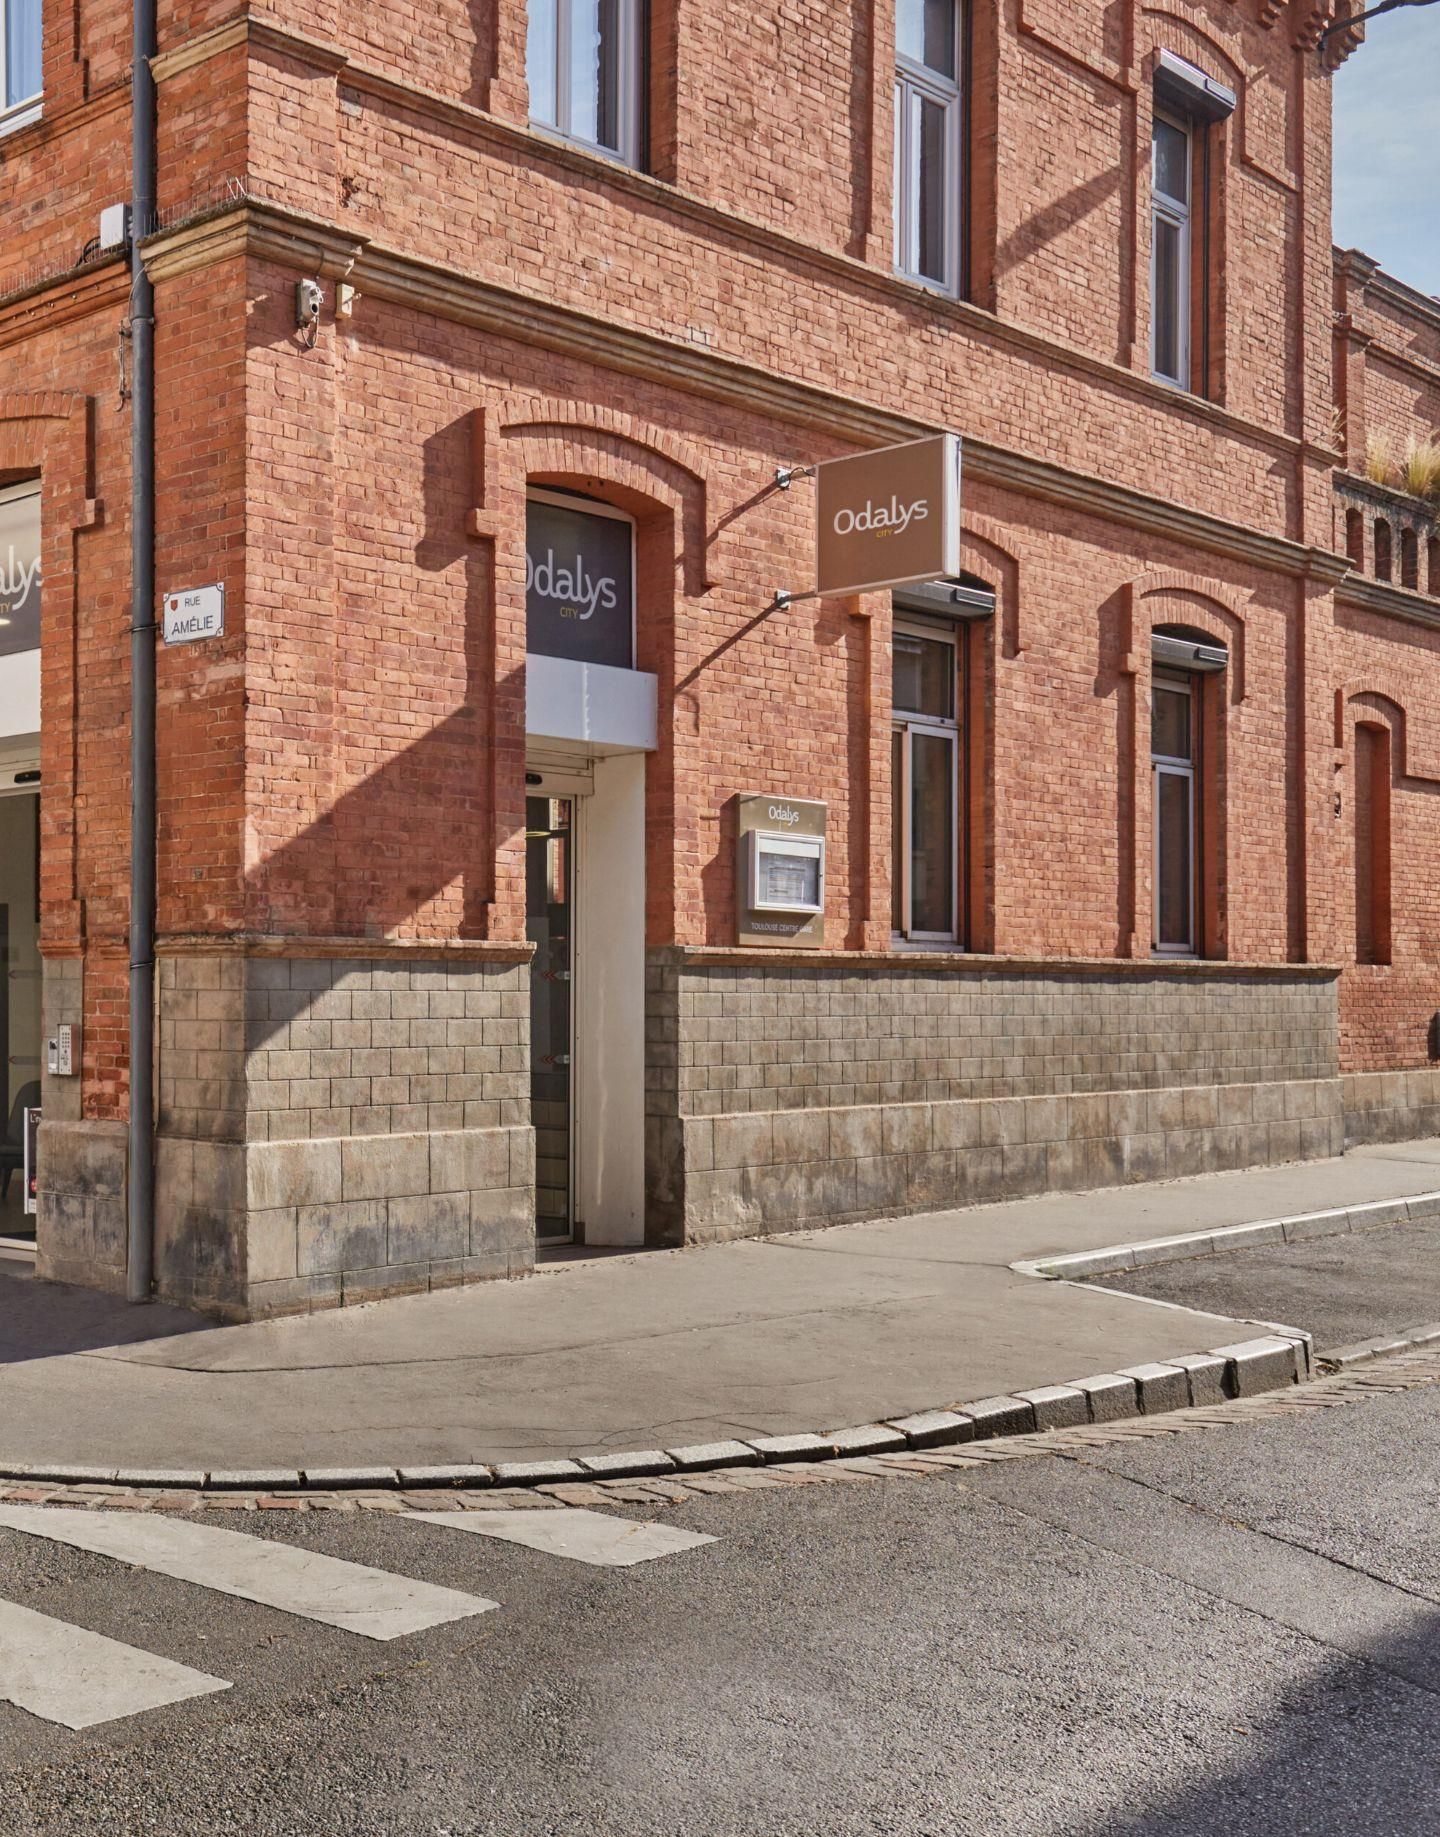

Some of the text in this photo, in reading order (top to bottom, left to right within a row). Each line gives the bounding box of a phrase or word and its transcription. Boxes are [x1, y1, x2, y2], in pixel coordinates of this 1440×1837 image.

[833, 495, 929, 535] Odalys
[875, 528, 893, 538] CITY
[184, 596, 201, 607] RUE
[560, 606, 578, 619] CITY
[171, 615, 214, 635] AMÉLIE
[768, 805, 799, 826] Odalys
